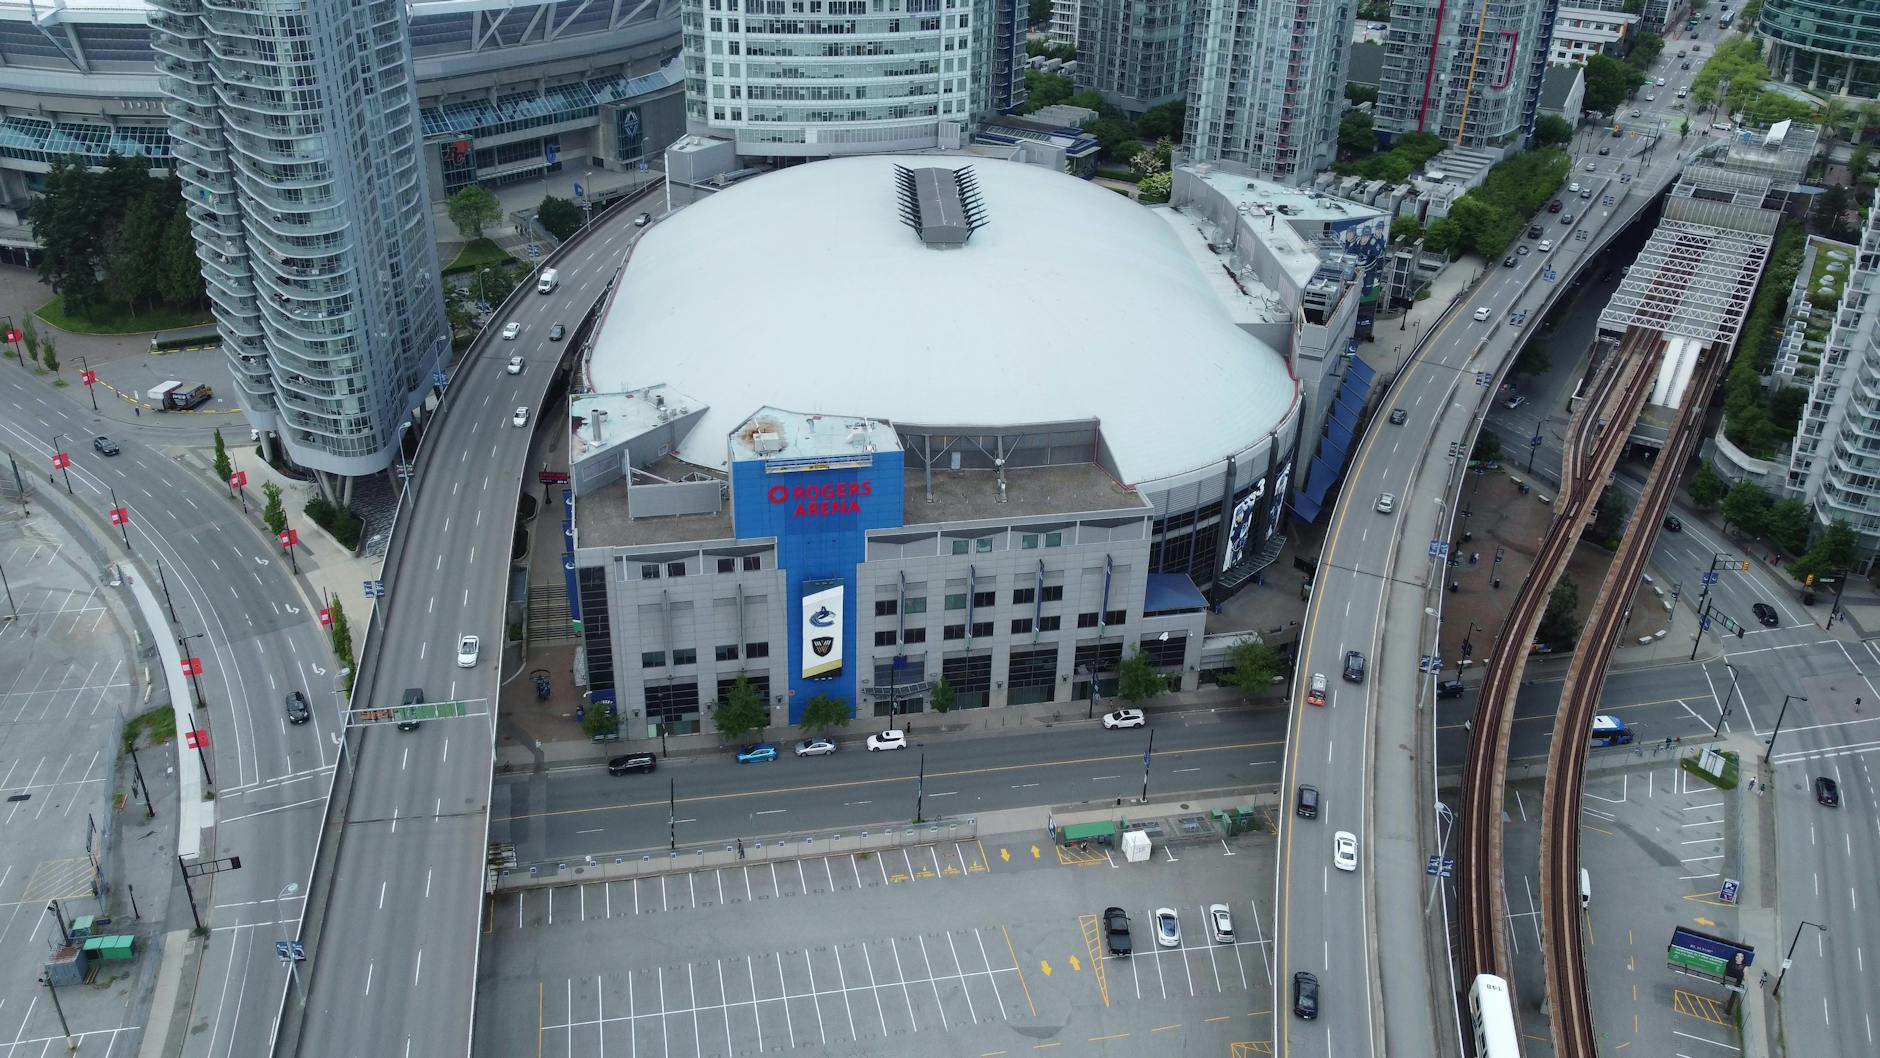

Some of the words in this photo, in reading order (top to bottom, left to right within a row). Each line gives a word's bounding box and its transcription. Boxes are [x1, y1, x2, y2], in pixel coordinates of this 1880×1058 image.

[793, 481, 872, 501] ROGERS
[794, 500, 861, 517] ARENA
[1159, 631, 1169, 641] 4
